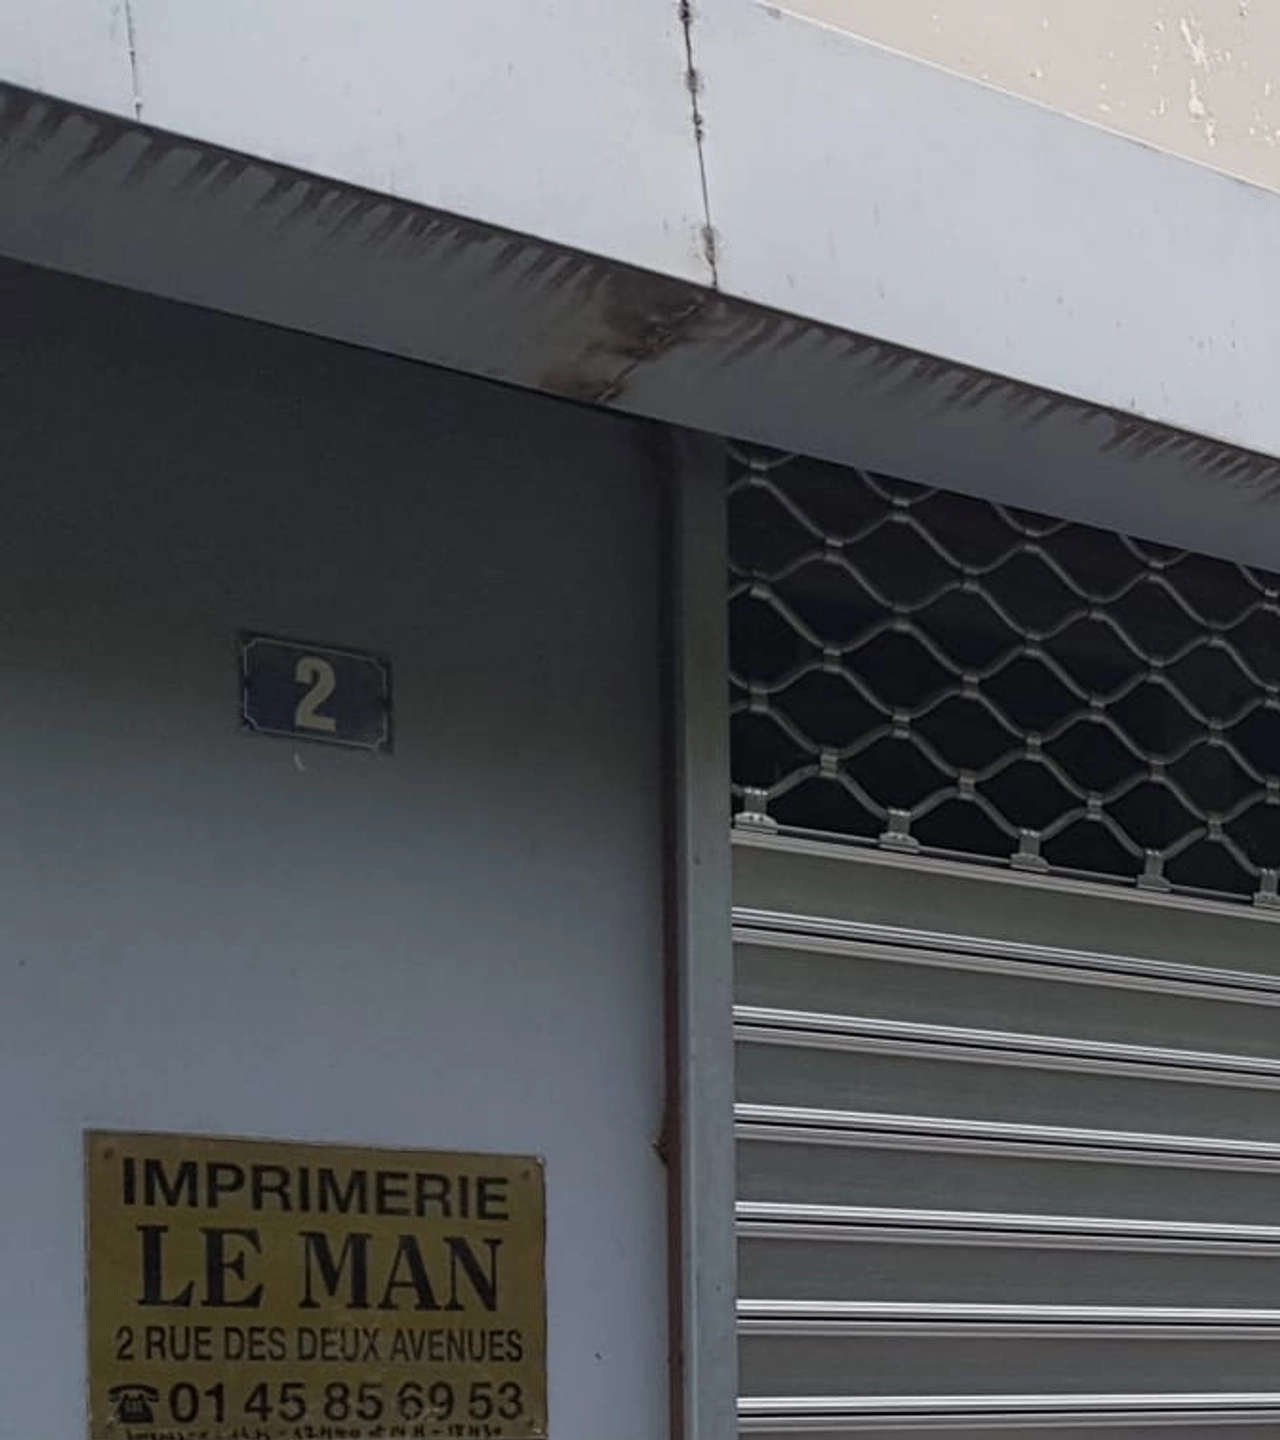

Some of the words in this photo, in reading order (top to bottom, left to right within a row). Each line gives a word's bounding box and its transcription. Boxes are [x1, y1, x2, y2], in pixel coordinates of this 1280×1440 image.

[295, 656, 336, 732] 2
[122, 1158, 510, 1220] IMPRIMERIE
[137, 1224, 264, 1310] LE
[300, 1231, 503, 1312] MAN
[115, 1326, 133, 1361] 2
[145, 1326, 213, 1361] RUE
[224, 1327, 286, 1362] DES
[300, 1328, 381, 1363] DEUX
[390, 1329, 524, 1363] AVENUES
[168, 1381, 226, 1424] 01
[244, 1381, 306, 1424] 45
[323, 1381, 384, 1423] 85
[400, 1381, 454, 1423] 69
[467, 1380, 524, 1422] 53
